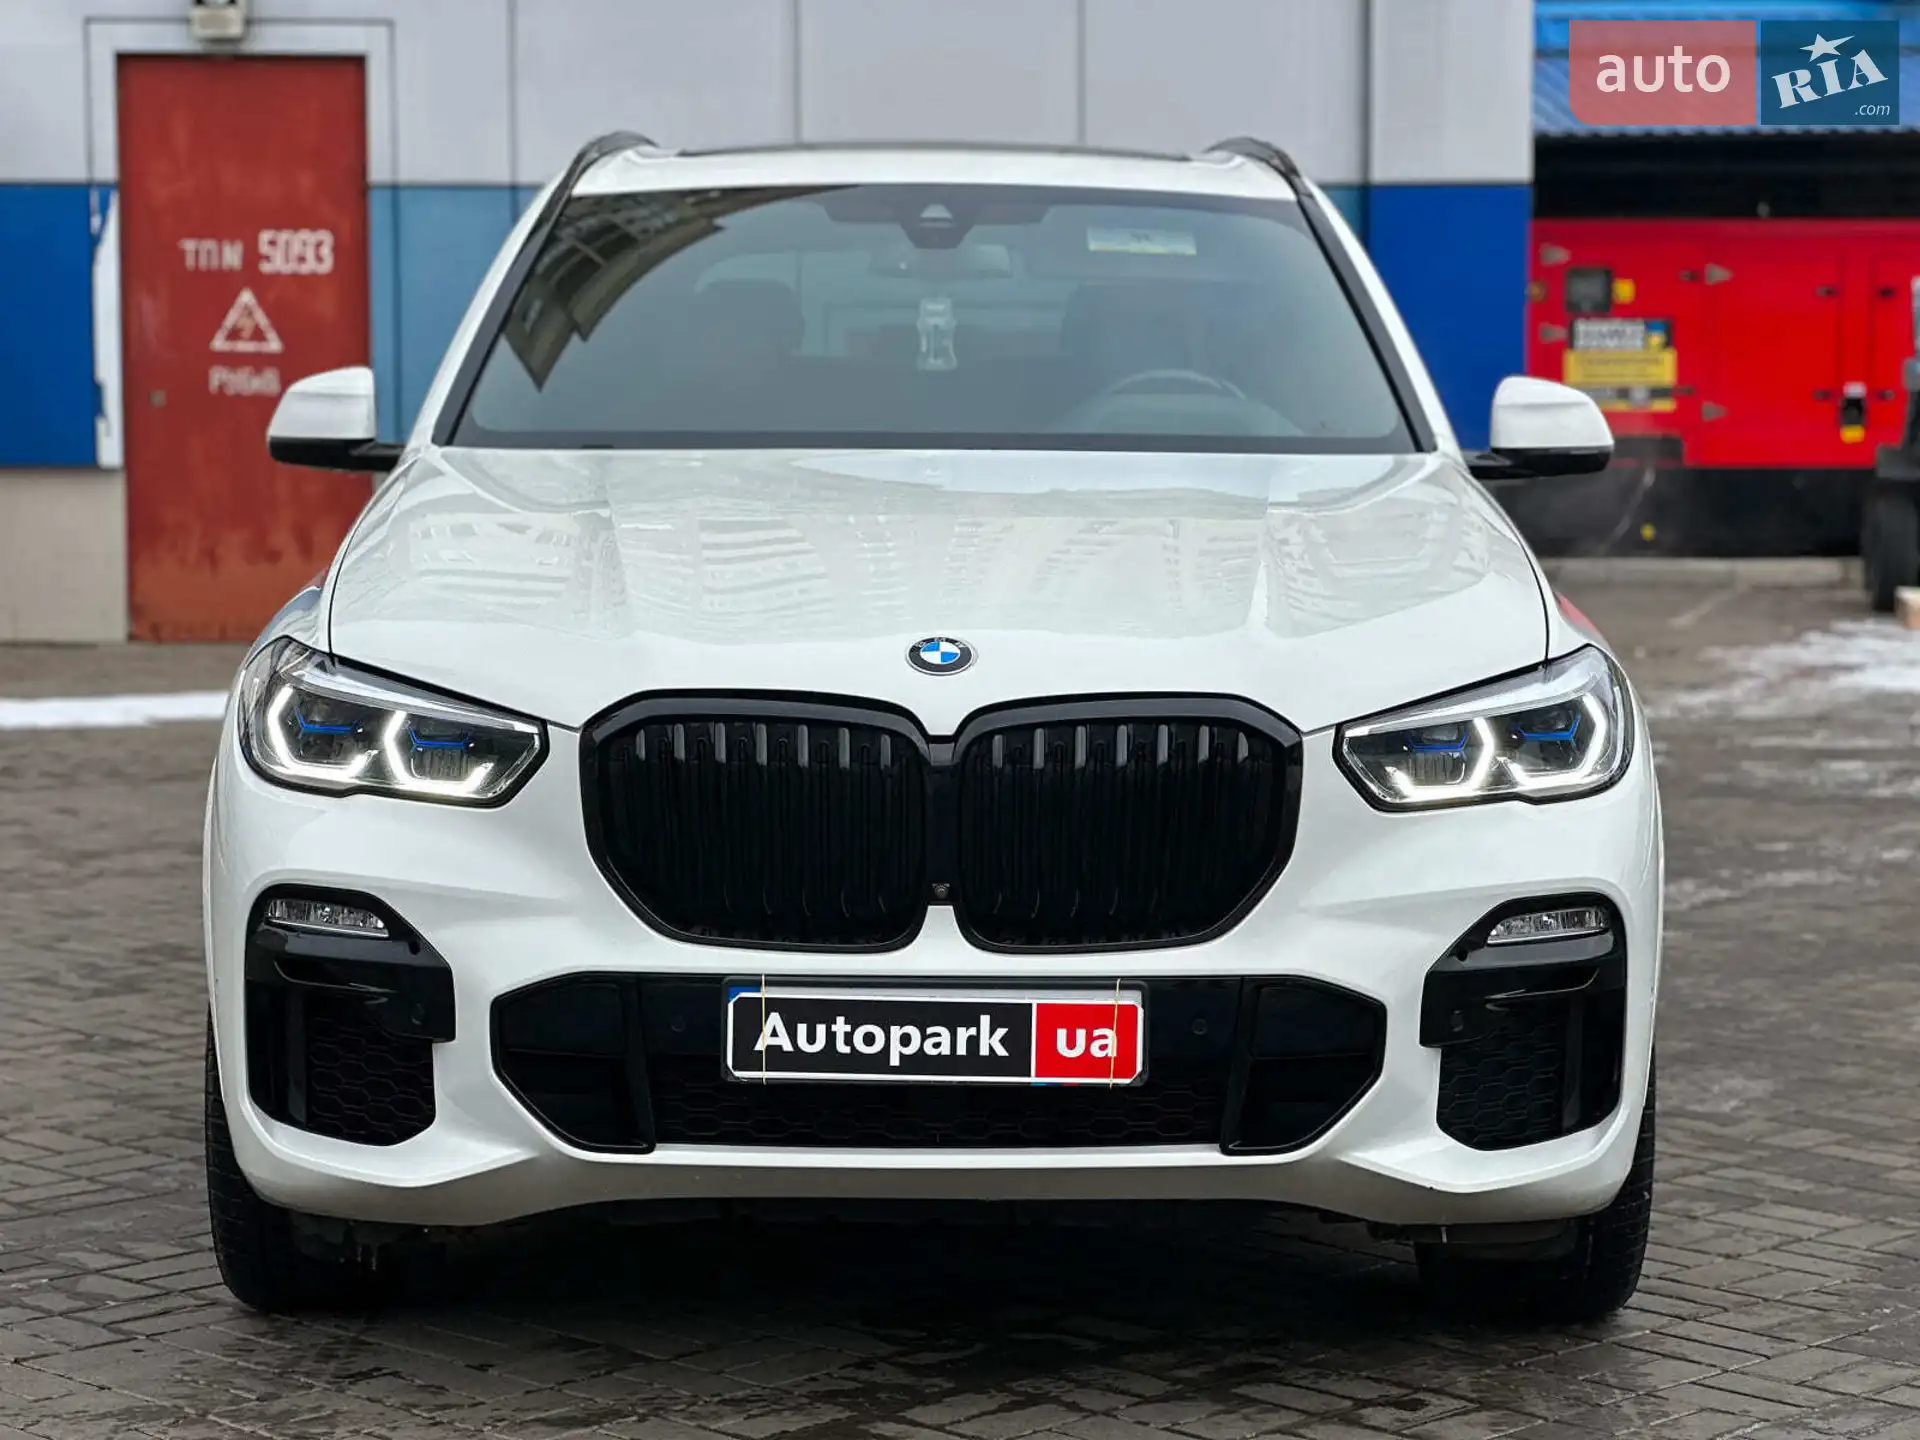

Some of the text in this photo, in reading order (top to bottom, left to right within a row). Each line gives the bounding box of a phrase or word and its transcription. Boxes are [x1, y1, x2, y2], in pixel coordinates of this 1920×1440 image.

[258, 228, 334, 275] 5093
[753, 1011, 1118, 1067] Autopark ua
